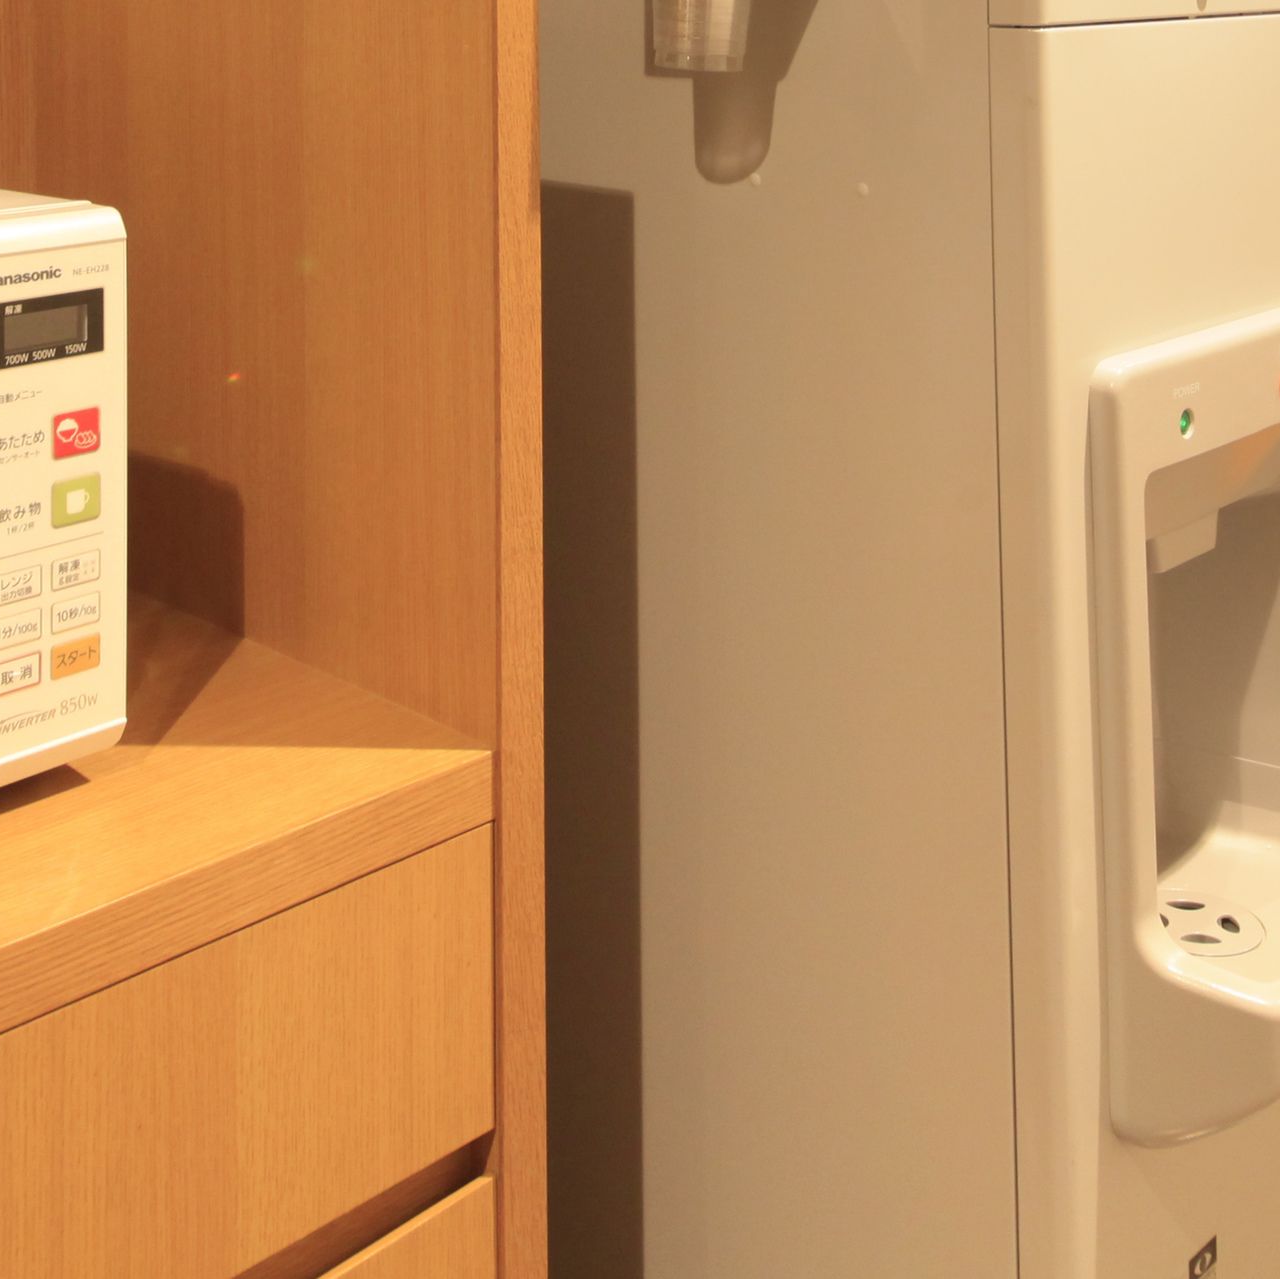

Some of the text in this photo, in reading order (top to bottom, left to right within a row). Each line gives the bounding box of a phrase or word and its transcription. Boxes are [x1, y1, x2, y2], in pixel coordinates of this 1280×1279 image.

[4, 342, 88, 367] 700W 500W 150W
[0, 571, 33, 591] レンジ
[56, 645, 97, 669] スタート
